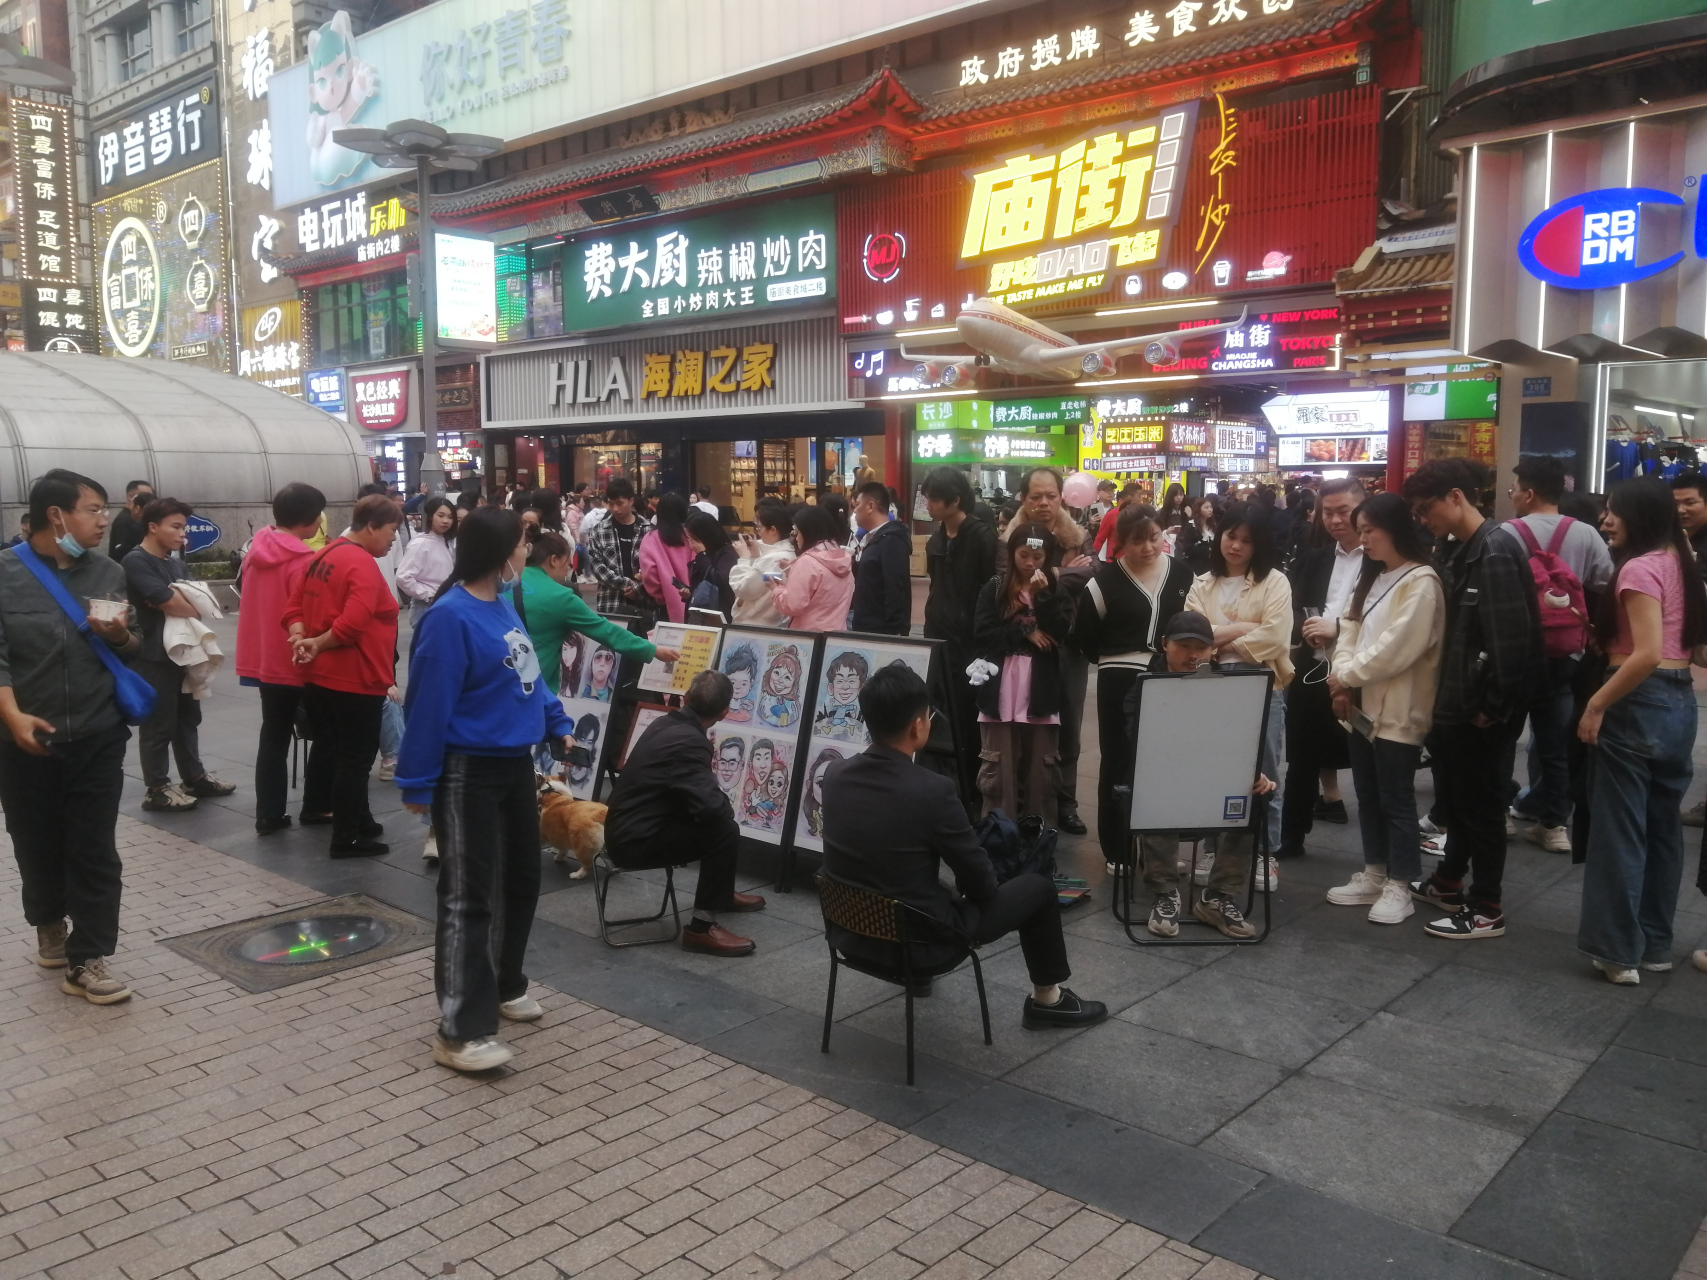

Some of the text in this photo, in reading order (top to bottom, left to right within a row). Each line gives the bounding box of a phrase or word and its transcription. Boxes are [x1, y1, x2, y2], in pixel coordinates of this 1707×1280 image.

[420, 0, 571, 105] 你好青春
[959, 25, 1101, 87] 政府授牌
[98, 93, 201, 186] 伊音琴行
[30, 115, 61, 273] 四喜富侨足道馆
[961, 126, 1157, 259] 庙街
[184, 210, 199, 235] 四
[298, 192, 368, 252] 电玩城
[1585, 210, 1635, 238] RB
[121, 235, 137, 265] 四
[357, 243, 401, 263] 庙街内2楼
[871, 243, 898, 268] MJ
[583, 230, 826, 303] 费大厨 辣椒炒肉
[37, 287, 84, 306] 四喜
[191, 272, 208, 300] 喜
[1006, 290, 1034, 304] TASTE
[1035, 284, 1066, 298] MAKE
[1067, 279, 1084, 291] ME
[1086, 274, 1105, 287] FLY
[641, 287, 755, 319] 全国小炒肉大王
[1272, 308, 1338, 323] NEW YORK
[38, 310, 86, 330] 馄饨
[125, 311, 143, 344] 喜
[1224, 324, 1272, 349] 庙街
[1280, 335, 1335, 351] TOKYO
[1211, 358, 1274, 371] CHANGSHA
[1226, 352, 1258, 361] MIAOJIE
[1293, 355, 1327, 368] PARIS
[549, 342, 777, 405] HLA 海澜之家
[355, 378, 401, 403] 黑色经典
[922, 402, 953, 420] 长沙
[995, 405, 1032, 422] 费大厨
[1064, 411, 1082, 420] 上2楼
[1096, 398, 1142, 418] 费大厨
[1174, 402, 1189, 413] 2楼
[917, 433, 953, 458] 柠季
[984, 435, 1010, 458] 柠季
